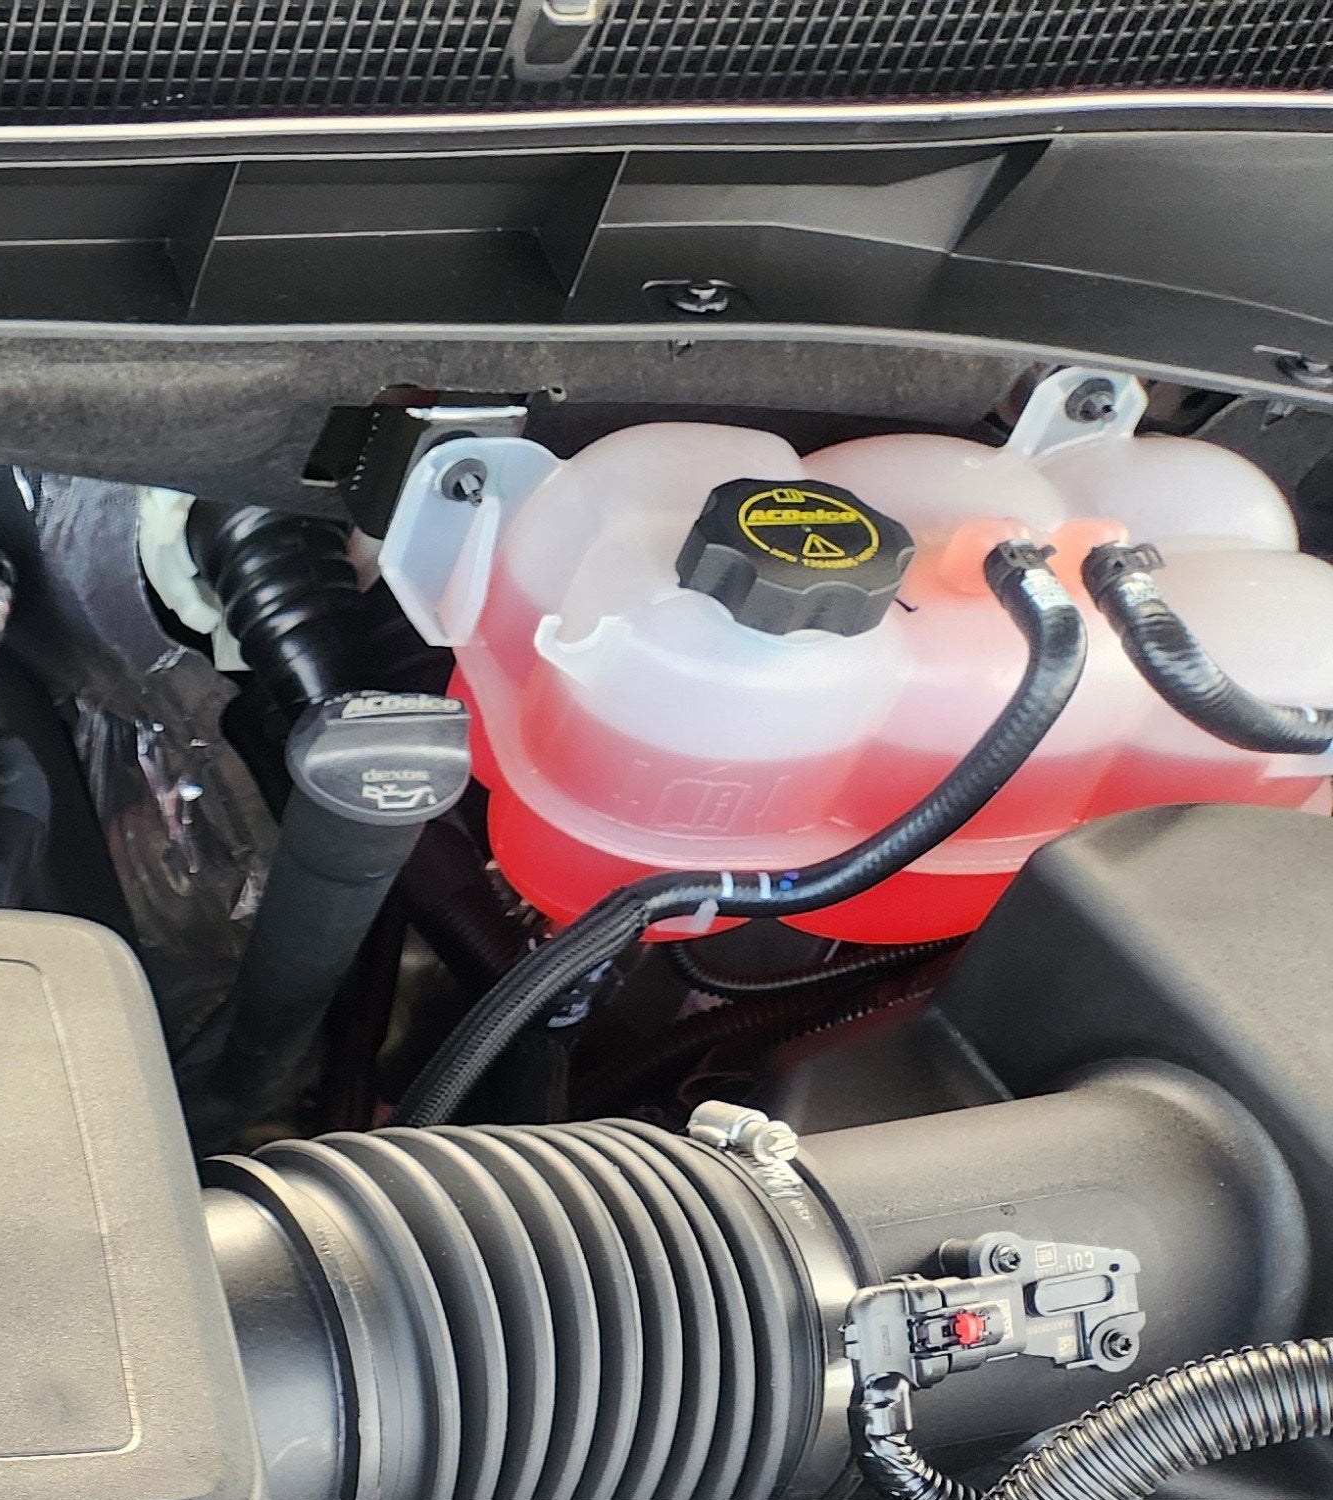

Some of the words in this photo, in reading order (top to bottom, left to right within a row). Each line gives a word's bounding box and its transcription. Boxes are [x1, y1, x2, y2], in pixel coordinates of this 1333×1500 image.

[747, 509, 859, 524] ACDelco
[341, 694, 463, 719] ACDelco
[361, 768, 431, 783] dexos
[1067, 1250, 1095, 1272] C01
